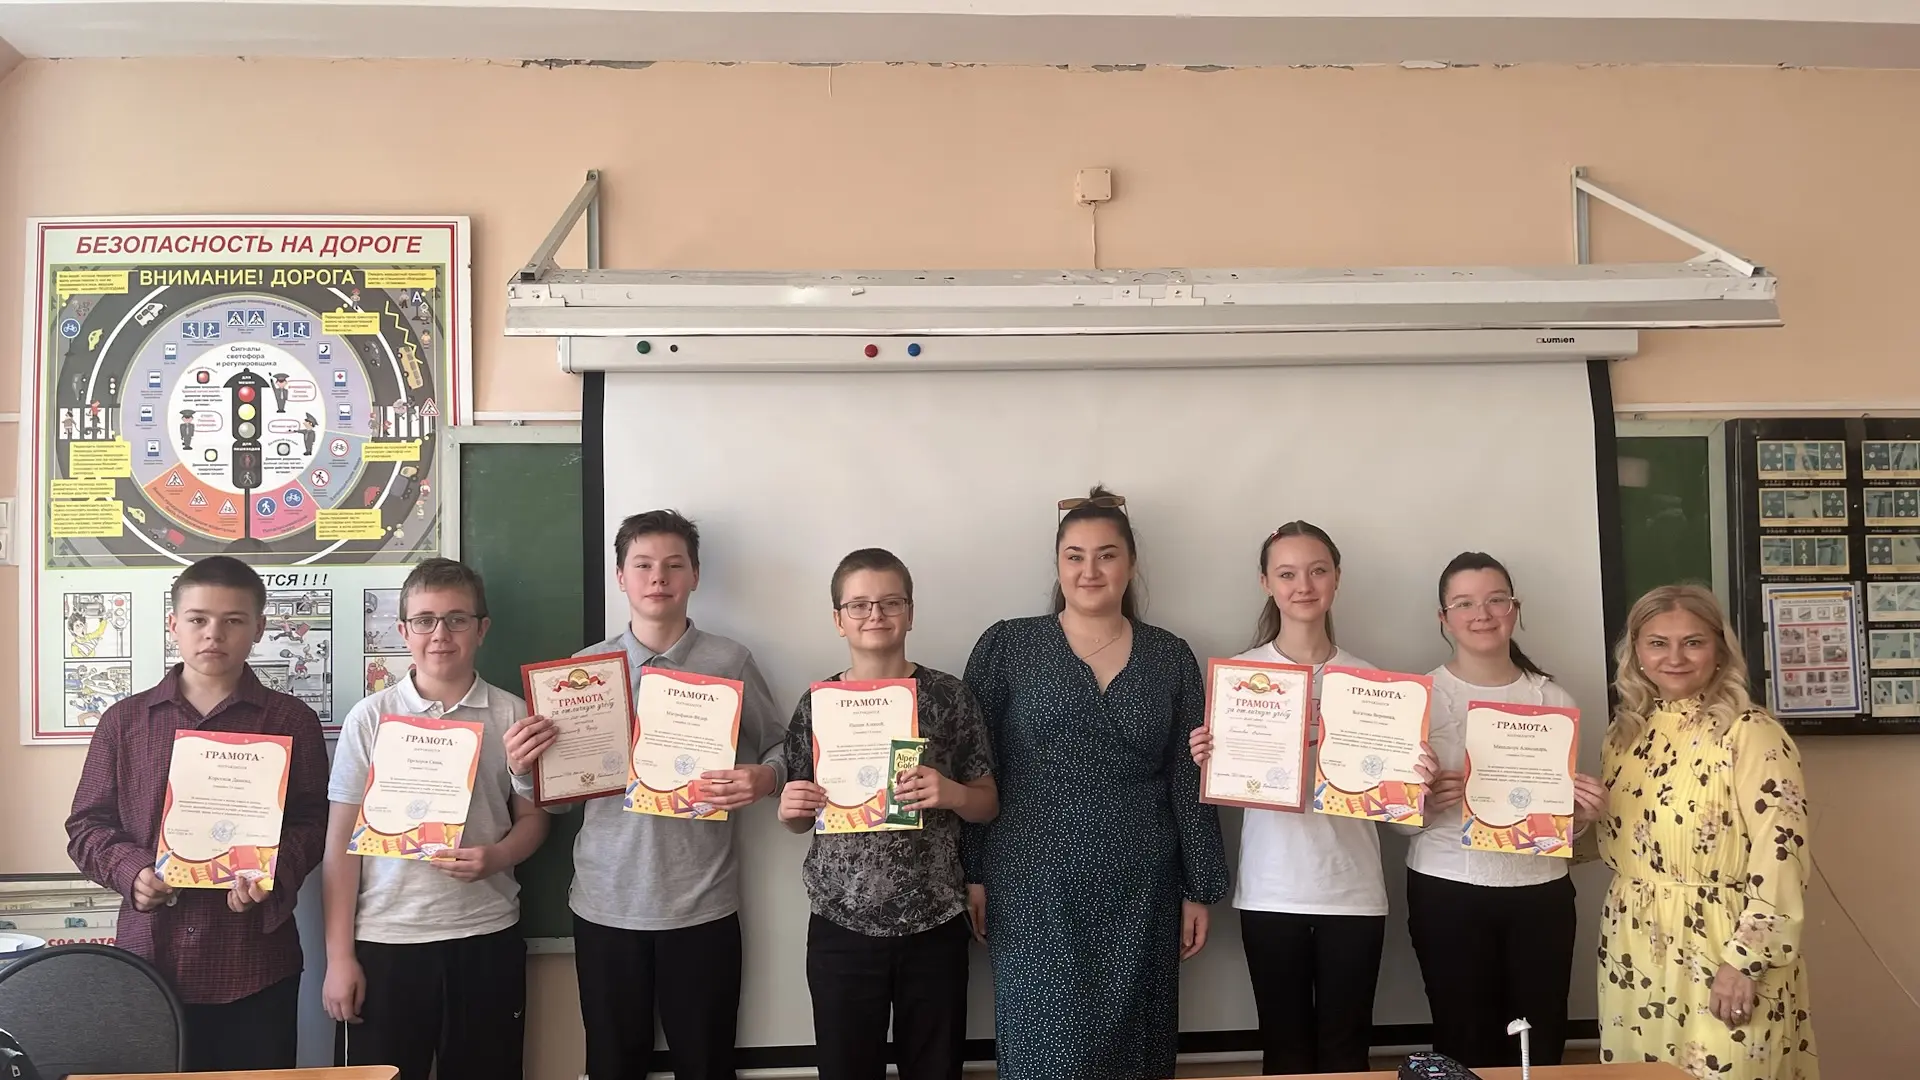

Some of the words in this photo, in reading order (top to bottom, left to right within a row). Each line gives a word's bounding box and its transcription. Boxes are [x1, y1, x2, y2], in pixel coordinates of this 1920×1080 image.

[76, 235, 274, 254] БЕЗОПАСНОСТЬ
[280, 235, 314, 254] НА
[319, 235, 423, 258] ДОРОГЕ
[140, 269, 263, 286] ВНИМАНИЕ!
[271, 268, 356, 288] ДОРОГА
[668, 688, 715, 702] ГРАМОТА
[1351, 687, 1402, 700] ГРАМОТА
[559, 693, 604, 707] ГРАМОТА
[840, 698, 889, 708] ГРАМОТА
[1236, 698, 1281, 709] ГРАМОТА
[1497, 721, 1548, 732] ГРАМОТА
[406, 734, 454, 746] ГРАМОТА
[205, 751, 260, 762] ГРАМОТА
[896, 753, 917, 763] Alpen
